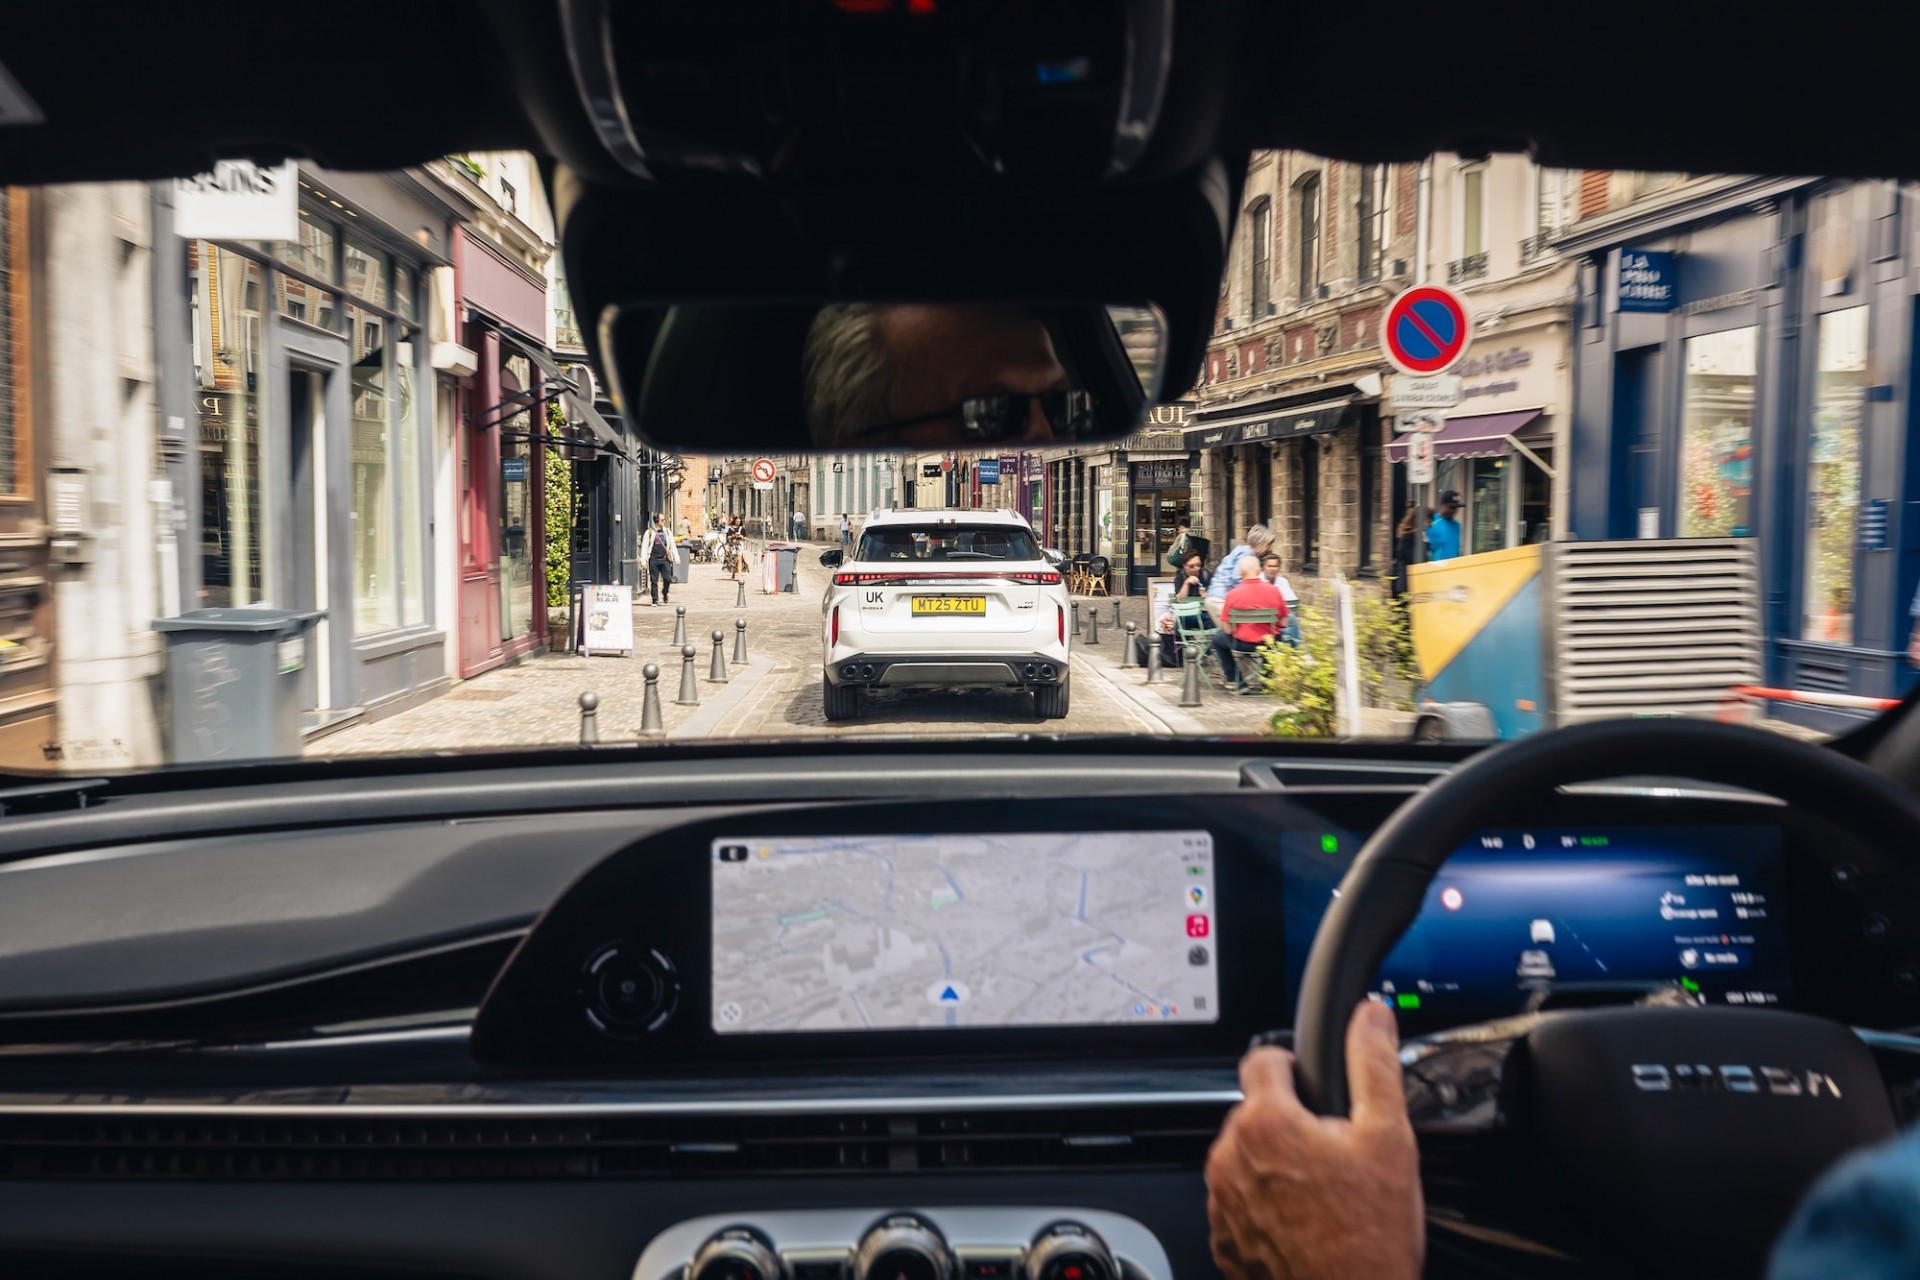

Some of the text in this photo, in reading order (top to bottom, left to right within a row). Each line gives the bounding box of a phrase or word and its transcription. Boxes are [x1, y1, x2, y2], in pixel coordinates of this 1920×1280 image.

[866, 592, 884, 603] UK
[917, 600, 979, 611] MT25 ZTU
